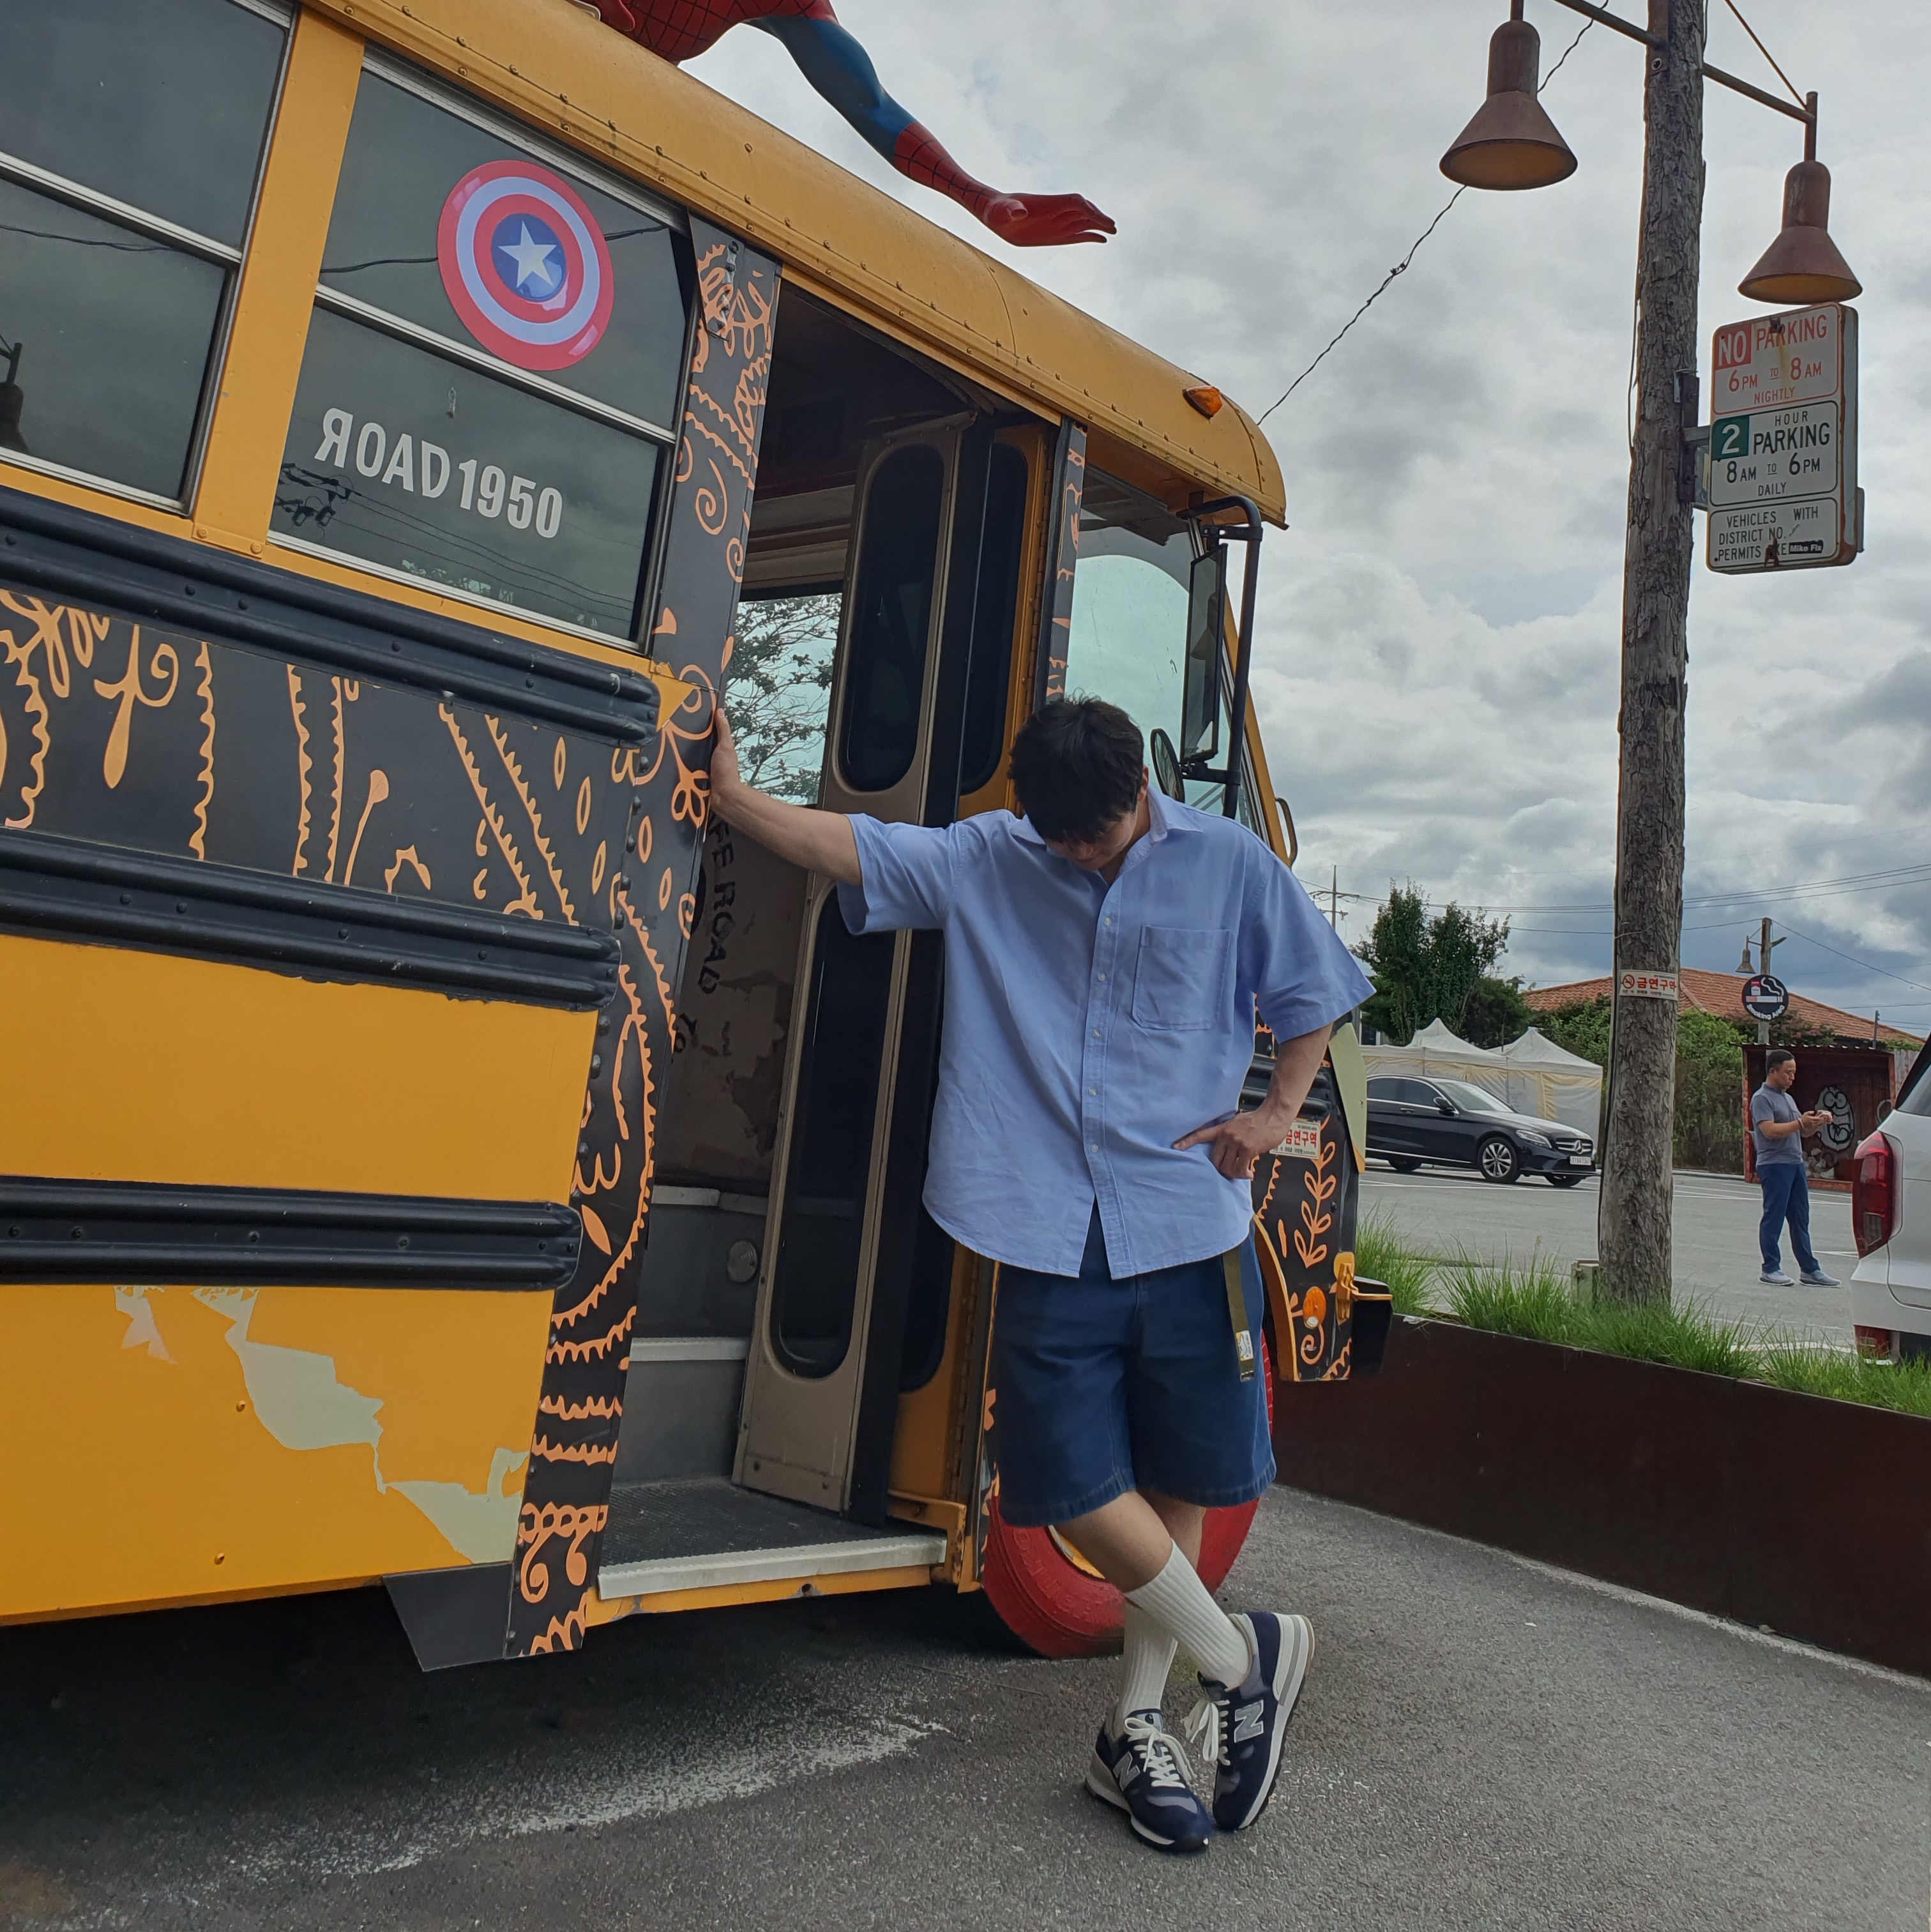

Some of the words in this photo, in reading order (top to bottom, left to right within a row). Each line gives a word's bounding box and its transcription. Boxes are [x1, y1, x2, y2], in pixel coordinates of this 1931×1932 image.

[1718, 330, 1747, 367] NO
[1756, 314, 1827, 351] PARKING
[1770, 367, 1779, 378] TO
[1754, 386, 1795, 404] NIGHTLY
[1775, 411, 1808, 427] HOUR
[1721, 423, 1740, 455] 2
[1753, 422, 1830, 455] PARKING
[1767, 463, 1777, 474] TO
[1758, 482, 1787, 496] DAILY
[458, 459, 563, 538] 1950
[1726, 511, 1776, 528] VEHICLES
[1793, 506, 1819, 521] WITH
[1718, 528, 1764, 545] DISTRICT
[1769, 526, 1787, 540] NO.
[1718, 545, 1761, 561] PERMITS
[1636, 977, 1677, 993] 금연구역
[1746, 1003, 1771, 1021] Smoking
[1771, 1005, 1785, 1019] Area
